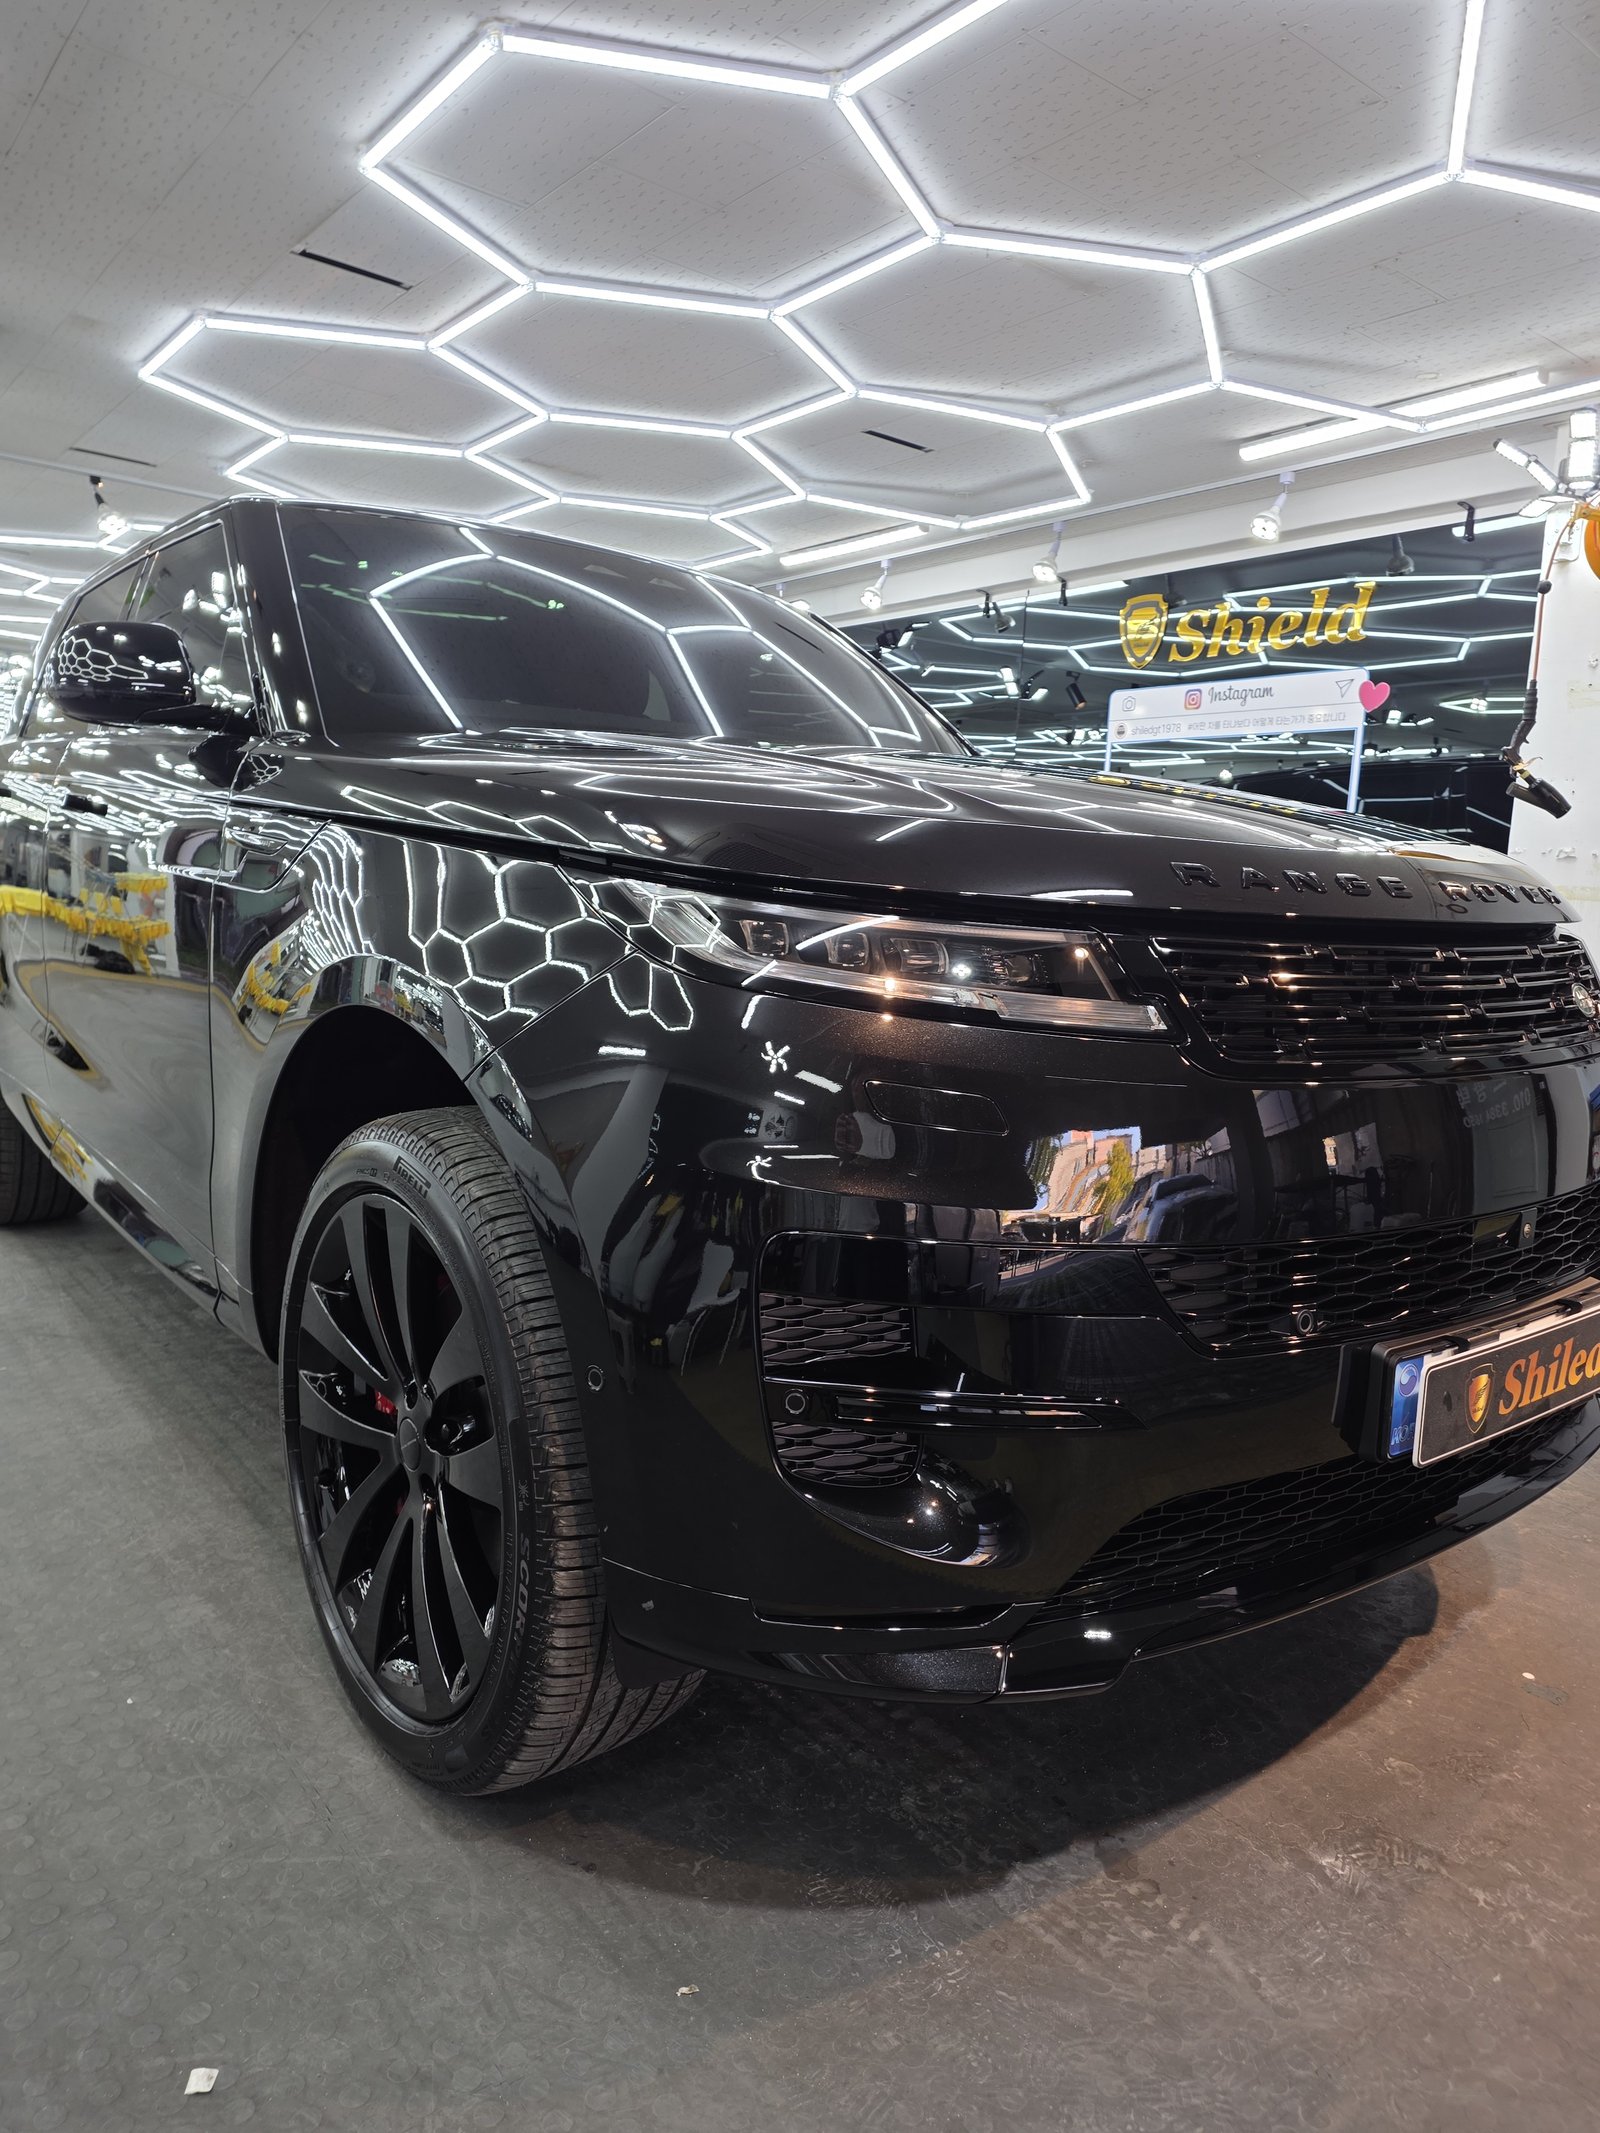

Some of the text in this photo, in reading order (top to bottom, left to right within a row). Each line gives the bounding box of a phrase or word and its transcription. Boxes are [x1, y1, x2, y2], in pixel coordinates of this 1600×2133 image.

[1168, 580, 1376, 662] Shield
[1207, 684, 1275, 707] Instagram
[1131, 722, 1182, 737] shiledgt1978
[1170, 860, 1562, 905] RANGE ROVER
[392, 1155, 432, 1199] PIRELLI
